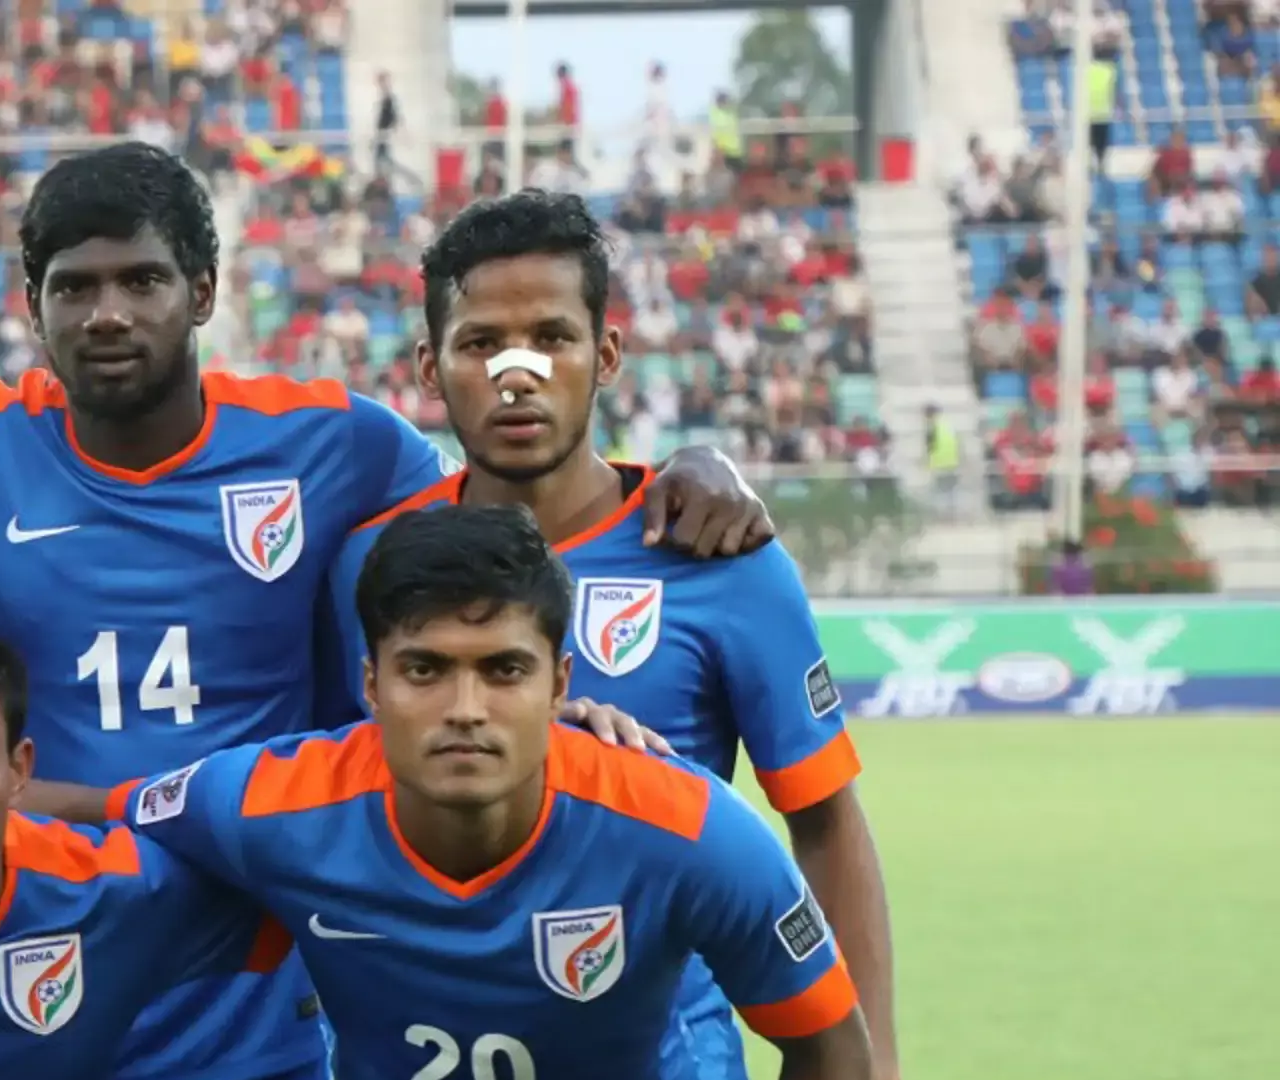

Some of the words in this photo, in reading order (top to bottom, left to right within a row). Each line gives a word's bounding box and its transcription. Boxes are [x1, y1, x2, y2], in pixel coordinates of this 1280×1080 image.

[237, 495, 276, 508] INDIA
[593, 590, 634, 601] INDIA
[78, 626, 201, 730] 14
[551, 922, 595, 936] INDIA
[14, 951, 55, 965] INDIA
